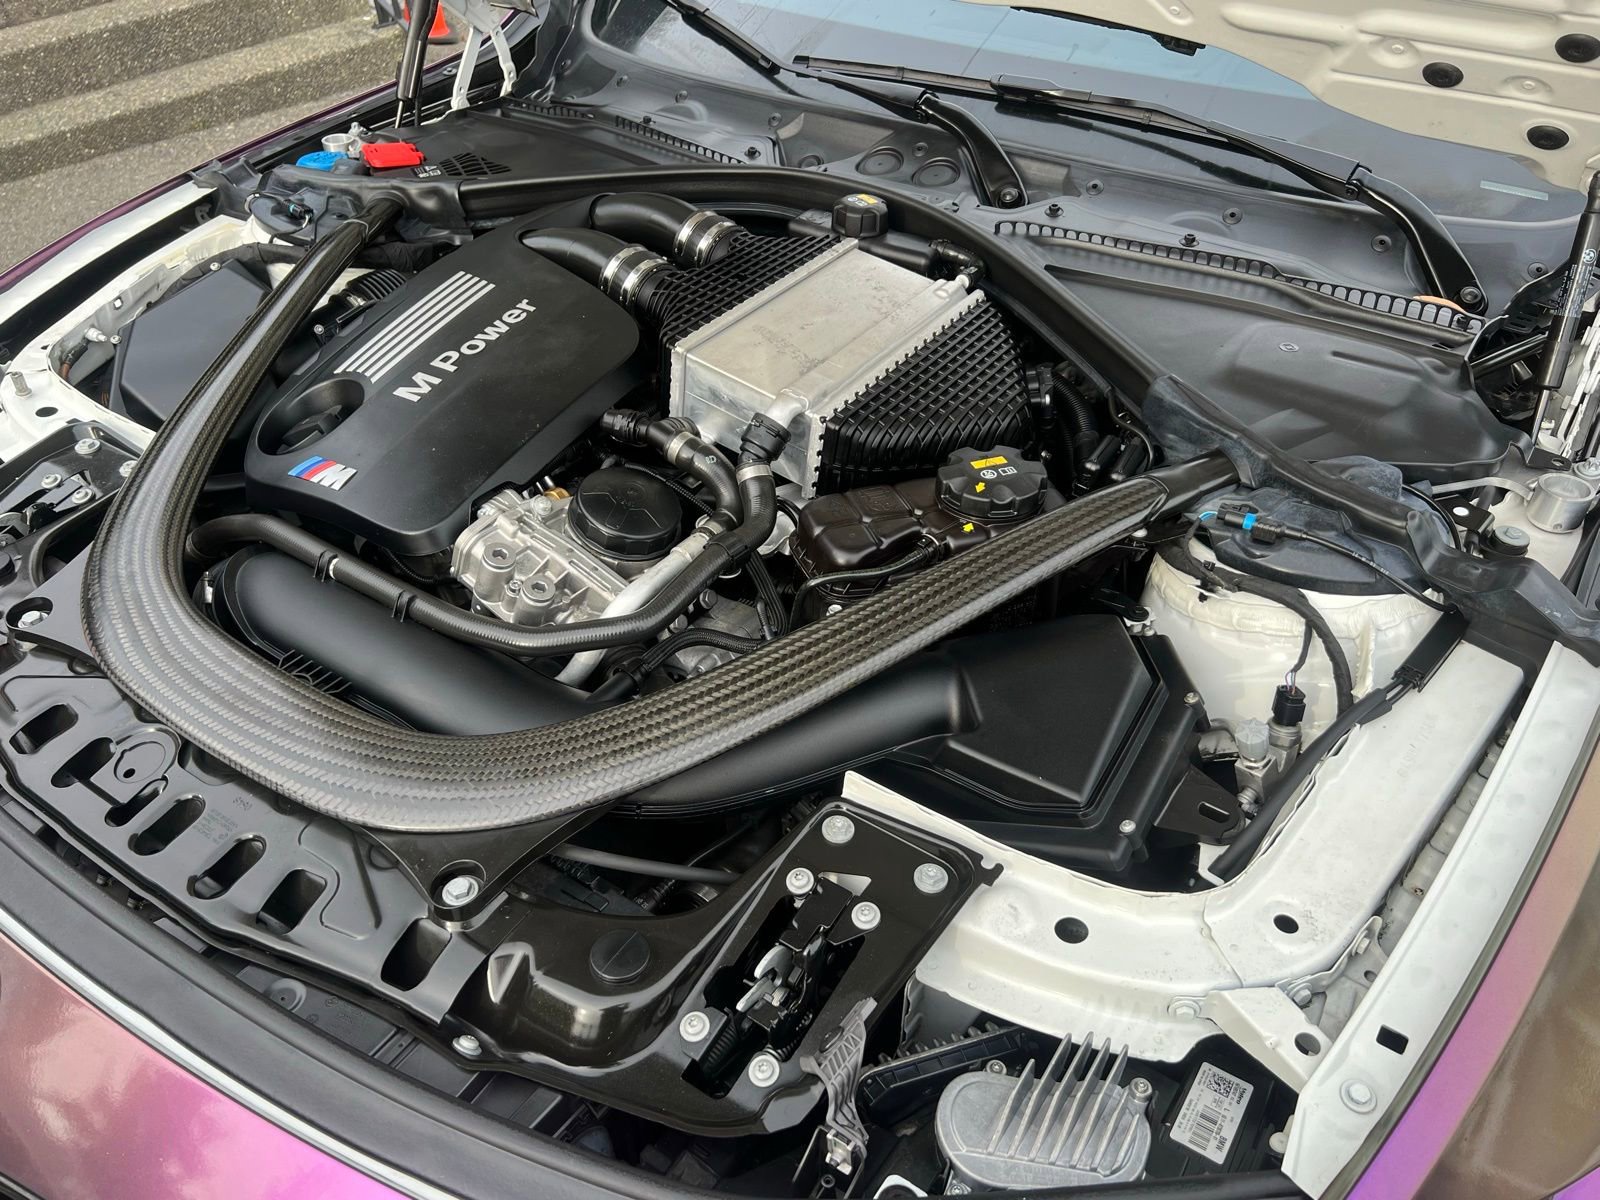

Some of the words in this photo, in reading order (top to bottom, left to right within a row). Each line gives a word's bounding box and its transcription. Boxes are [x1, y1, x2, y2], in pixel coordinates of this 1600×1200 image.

[393, 371, 442, 403] M
[430, 298, 537, 373] Power
[309, 462, 358, 491] M
[1215, 1135, 1228, 1153] BMW
